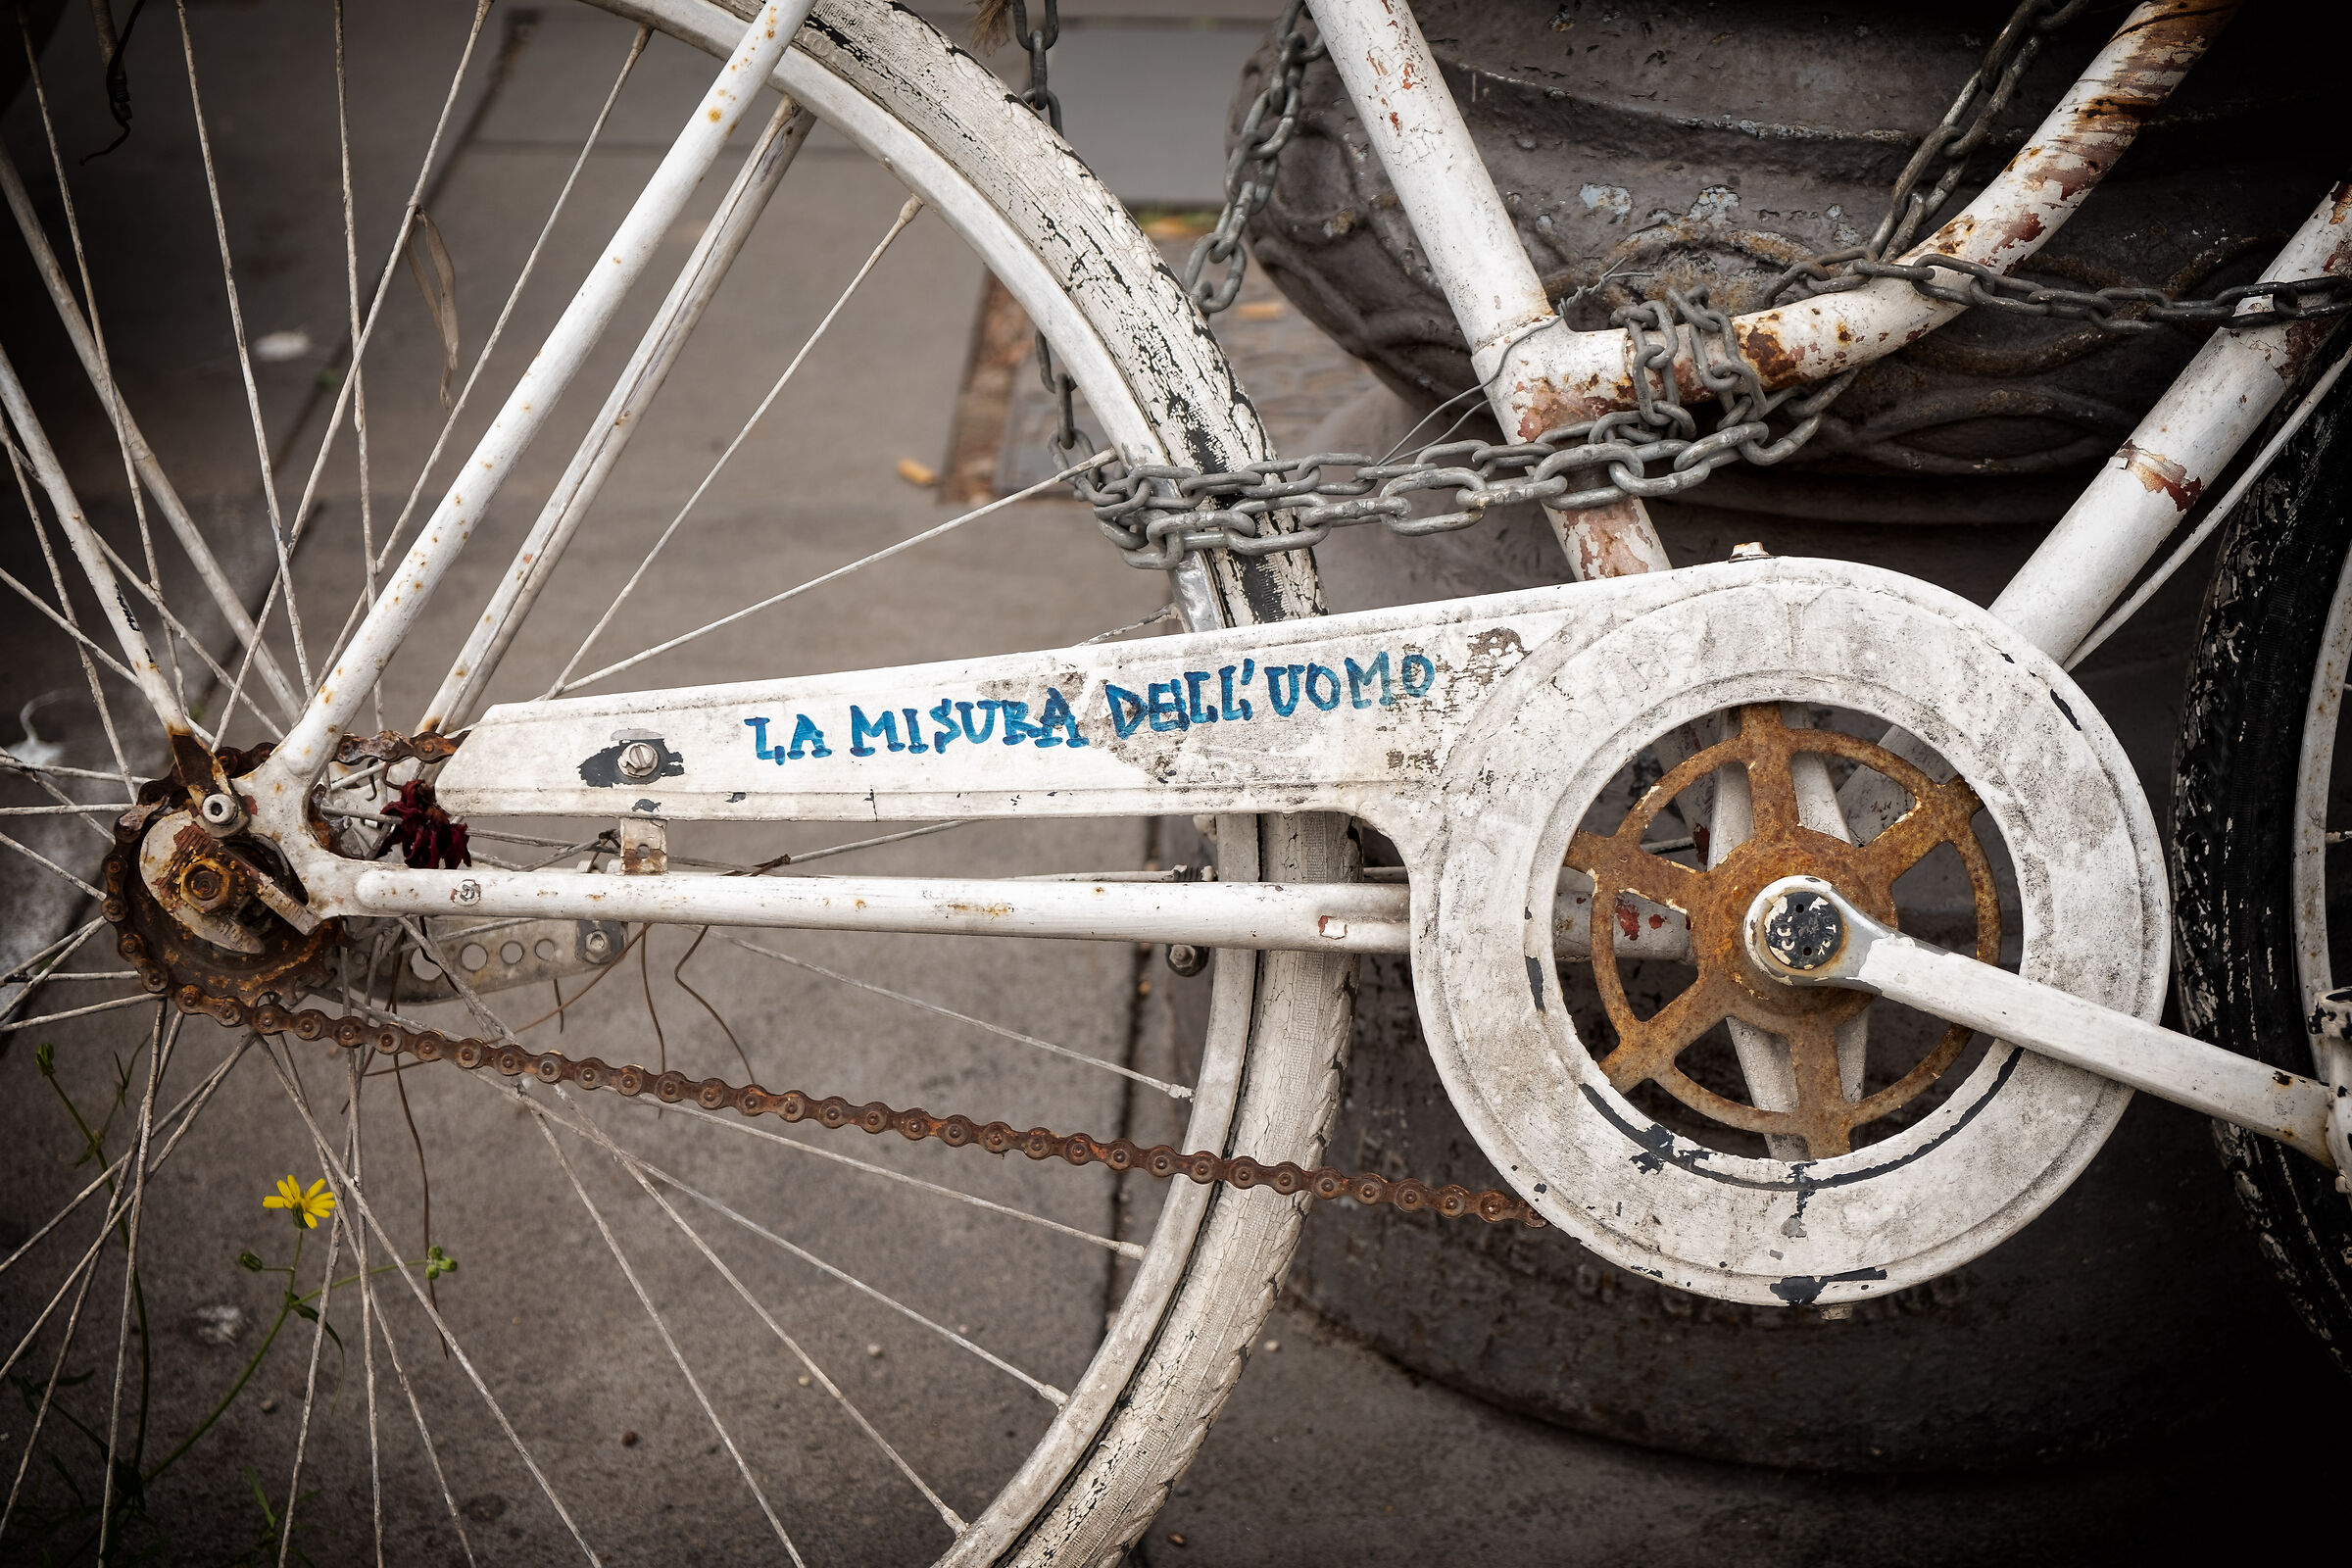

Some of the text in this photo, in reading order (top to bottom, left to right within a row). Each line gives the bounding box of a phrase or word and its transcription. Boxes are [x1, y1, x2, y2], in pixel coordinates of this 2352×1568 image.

[744, 651, 1435, 765] LA MISURA DELL'UOMO
